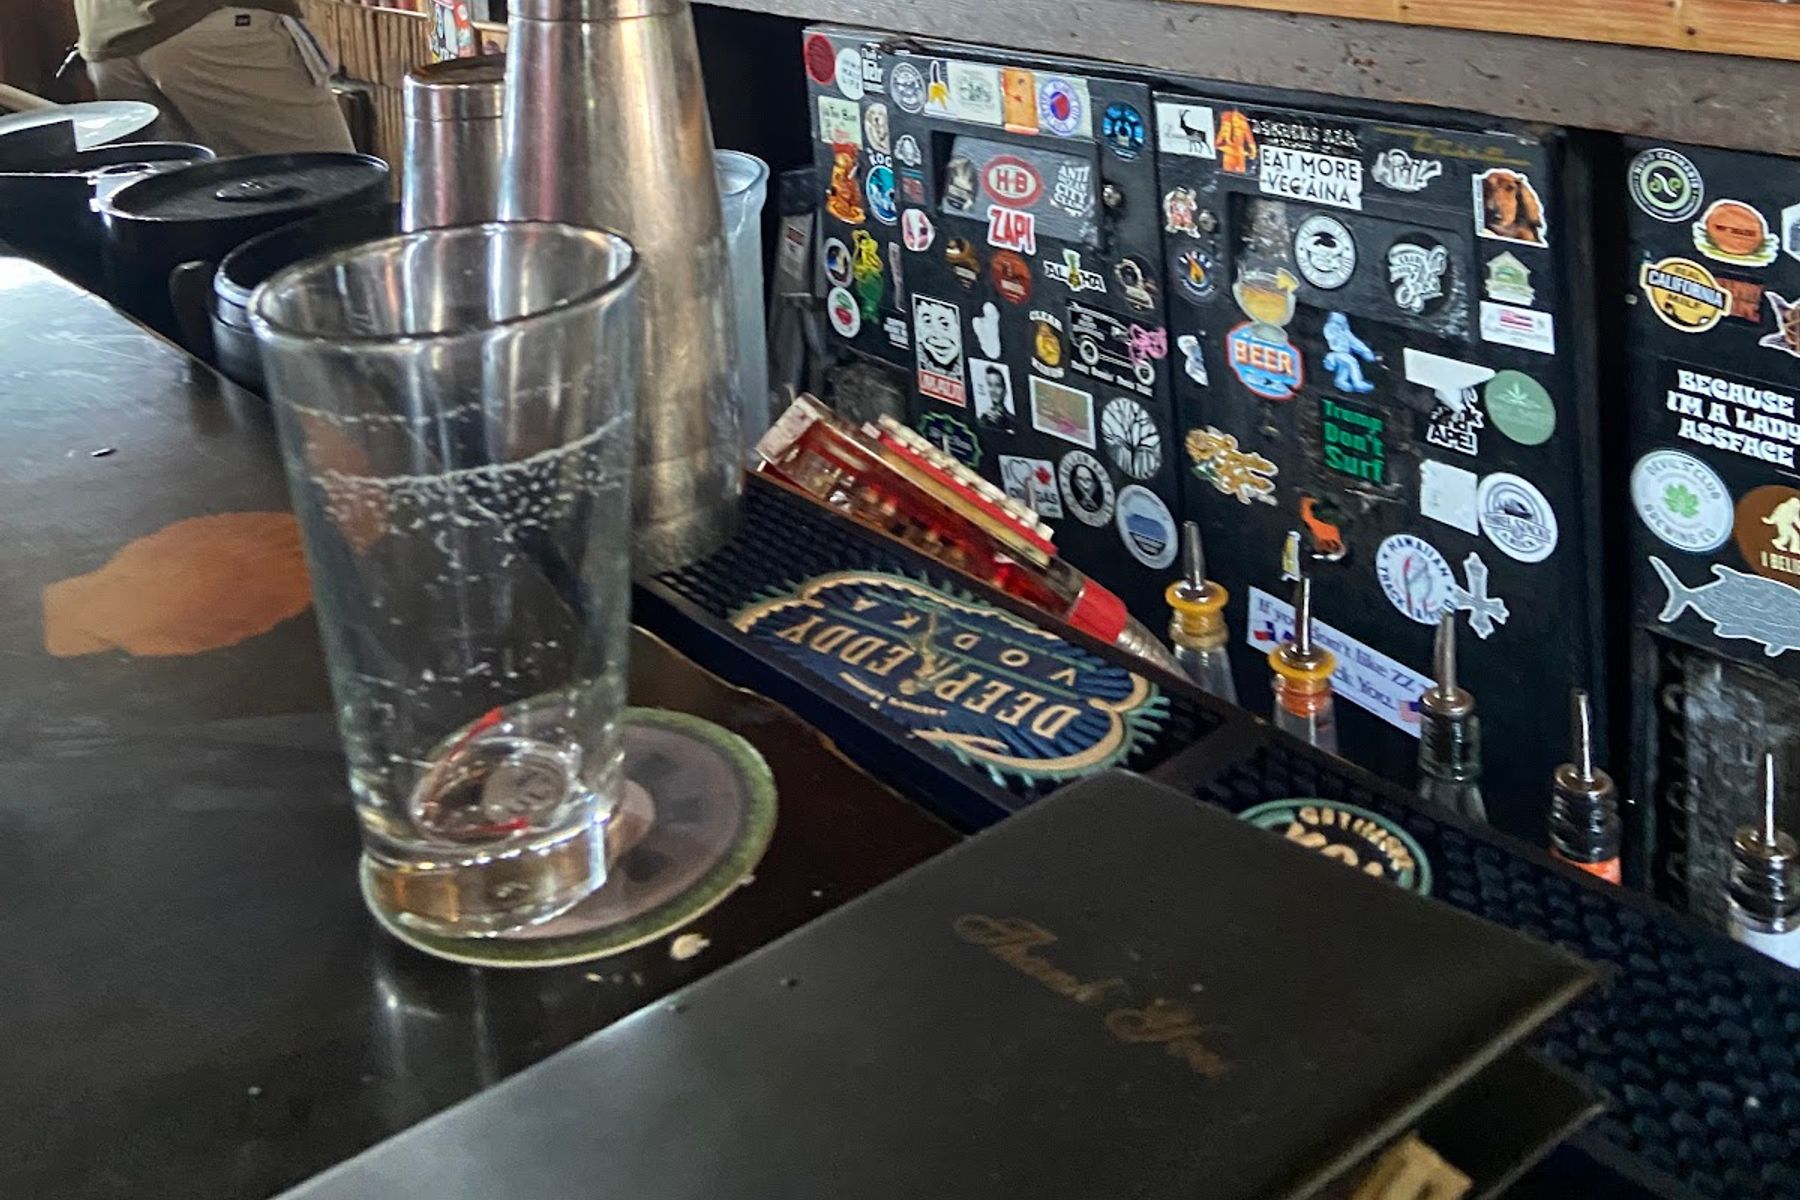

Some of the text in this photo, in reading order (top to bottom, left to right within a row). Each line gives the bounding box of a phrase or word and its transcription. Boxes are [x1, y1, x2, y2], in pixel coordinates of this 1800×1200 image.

[1263, 149, 1358, 182] EAT MORE
[1649, 270, 1724, 308] CALIFORNIA
[1235, 340, 1294, 376] BEER
[1677, 369, 1795, 418] BECAUSE
[1677, 418, 1795, 468] ASSFACE
[1708, 403, 1731, 426] A
[1735, 407, 1800, 445] LADY
[776, 615, 1082, 740] DEEP EDDY
